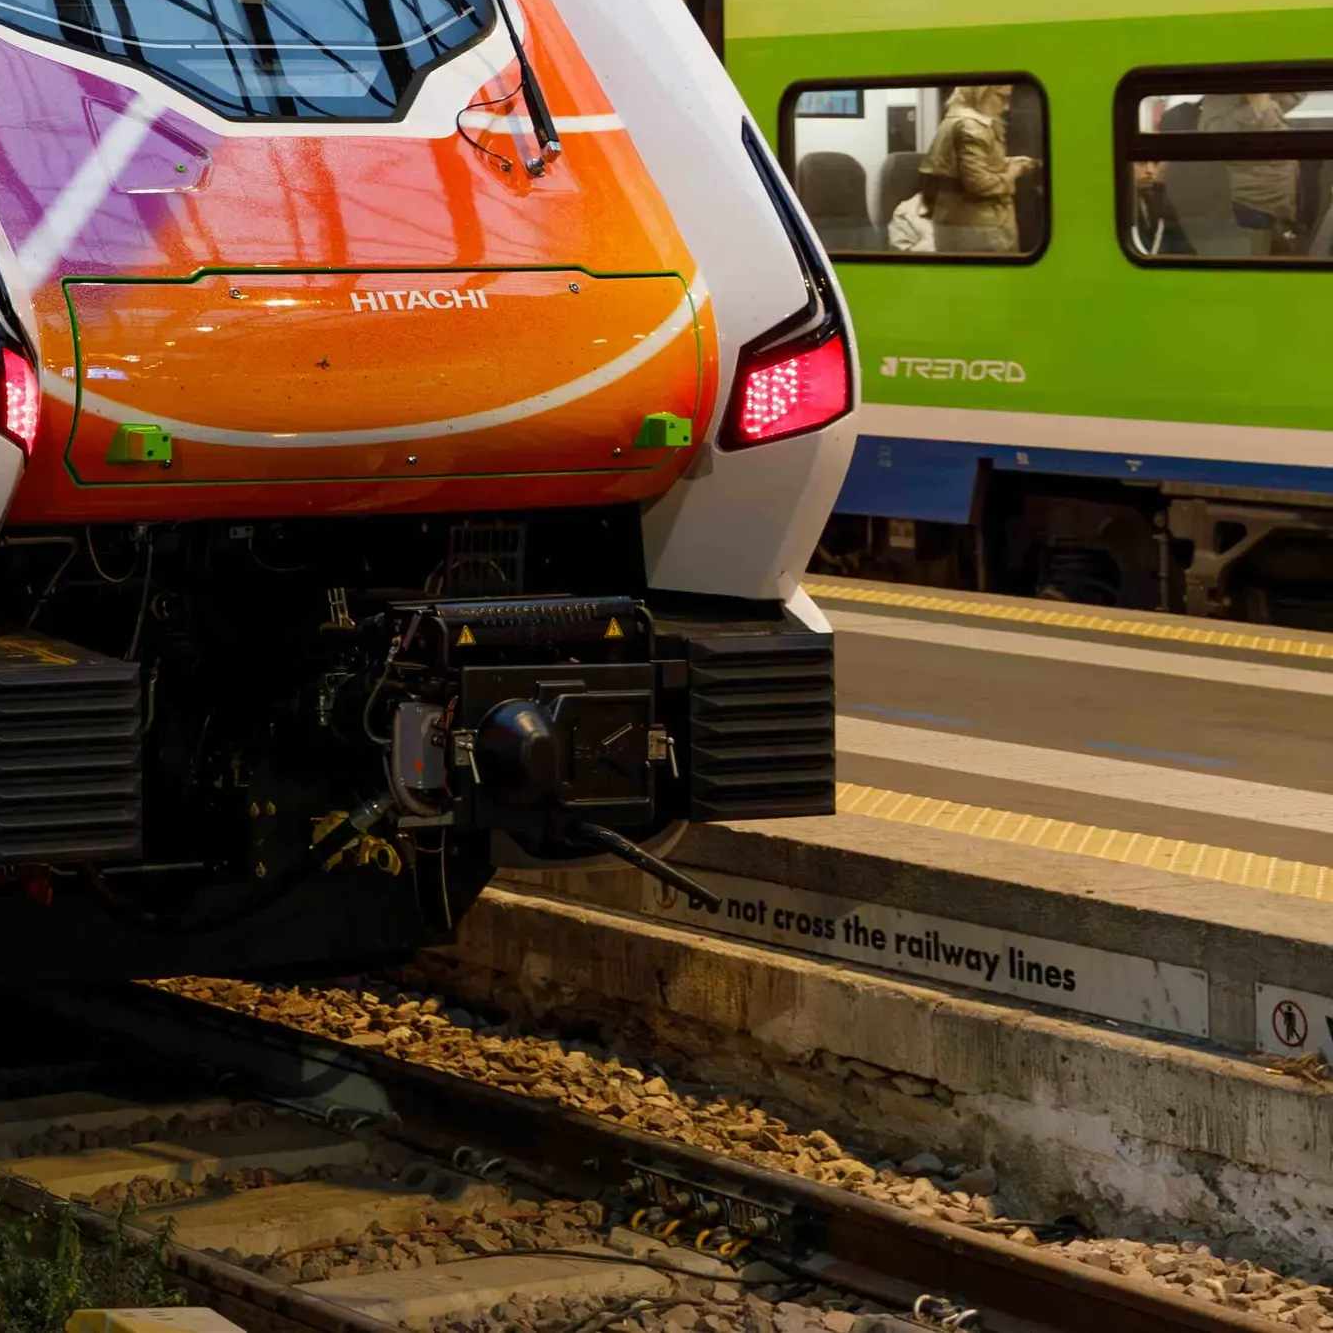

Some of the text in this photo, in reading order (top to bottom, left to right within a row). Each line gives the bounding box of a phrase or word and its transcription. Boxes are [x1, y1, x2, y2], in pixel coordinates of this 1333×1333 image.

[349, 289, 489, 312] HITACHI
[899, 357, 1026, 382] TRENORD
[727, 898, 767, 925] not
[773, 908, 836, 940] cross
[842, 915, 887, 951] the
[895, 931, 1000, 982] railway
[1008, 946, 1076, 992] lines
